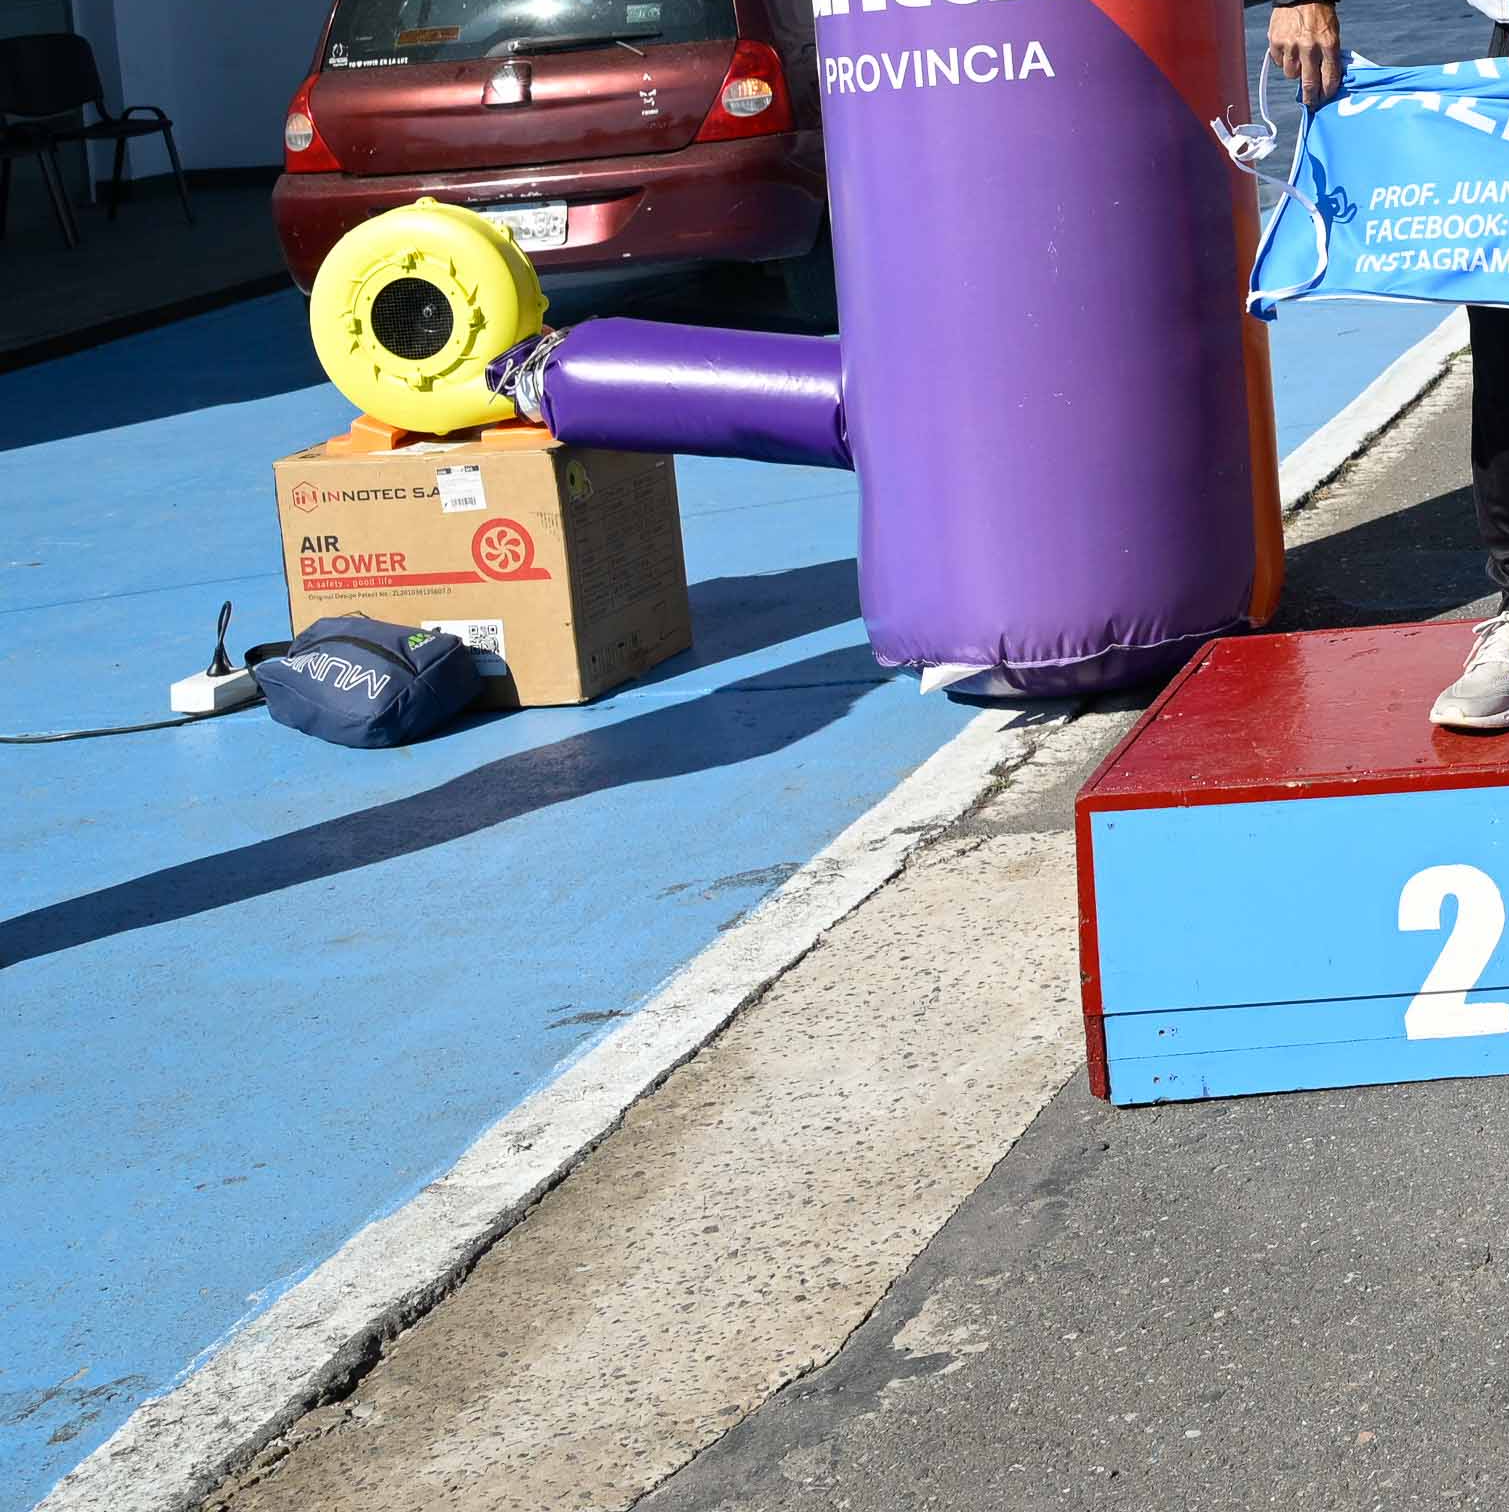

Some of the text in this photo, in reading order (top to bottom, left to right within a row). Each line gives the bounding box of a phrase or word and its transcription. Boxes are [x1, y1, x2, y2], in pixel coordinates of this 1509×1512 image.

[825, 40, 1055, 95] PROVINCIA
[1369, 183, 1440, 210] PROF.
[1365, 213, 1509, 245] FACEBOOK:
[322, 487, 407, 503] INNOTEC
[300, 535, 340, 553] AIR
[300, 552, 407, 576] BLOWER
[378, 578, 393, 586] life
